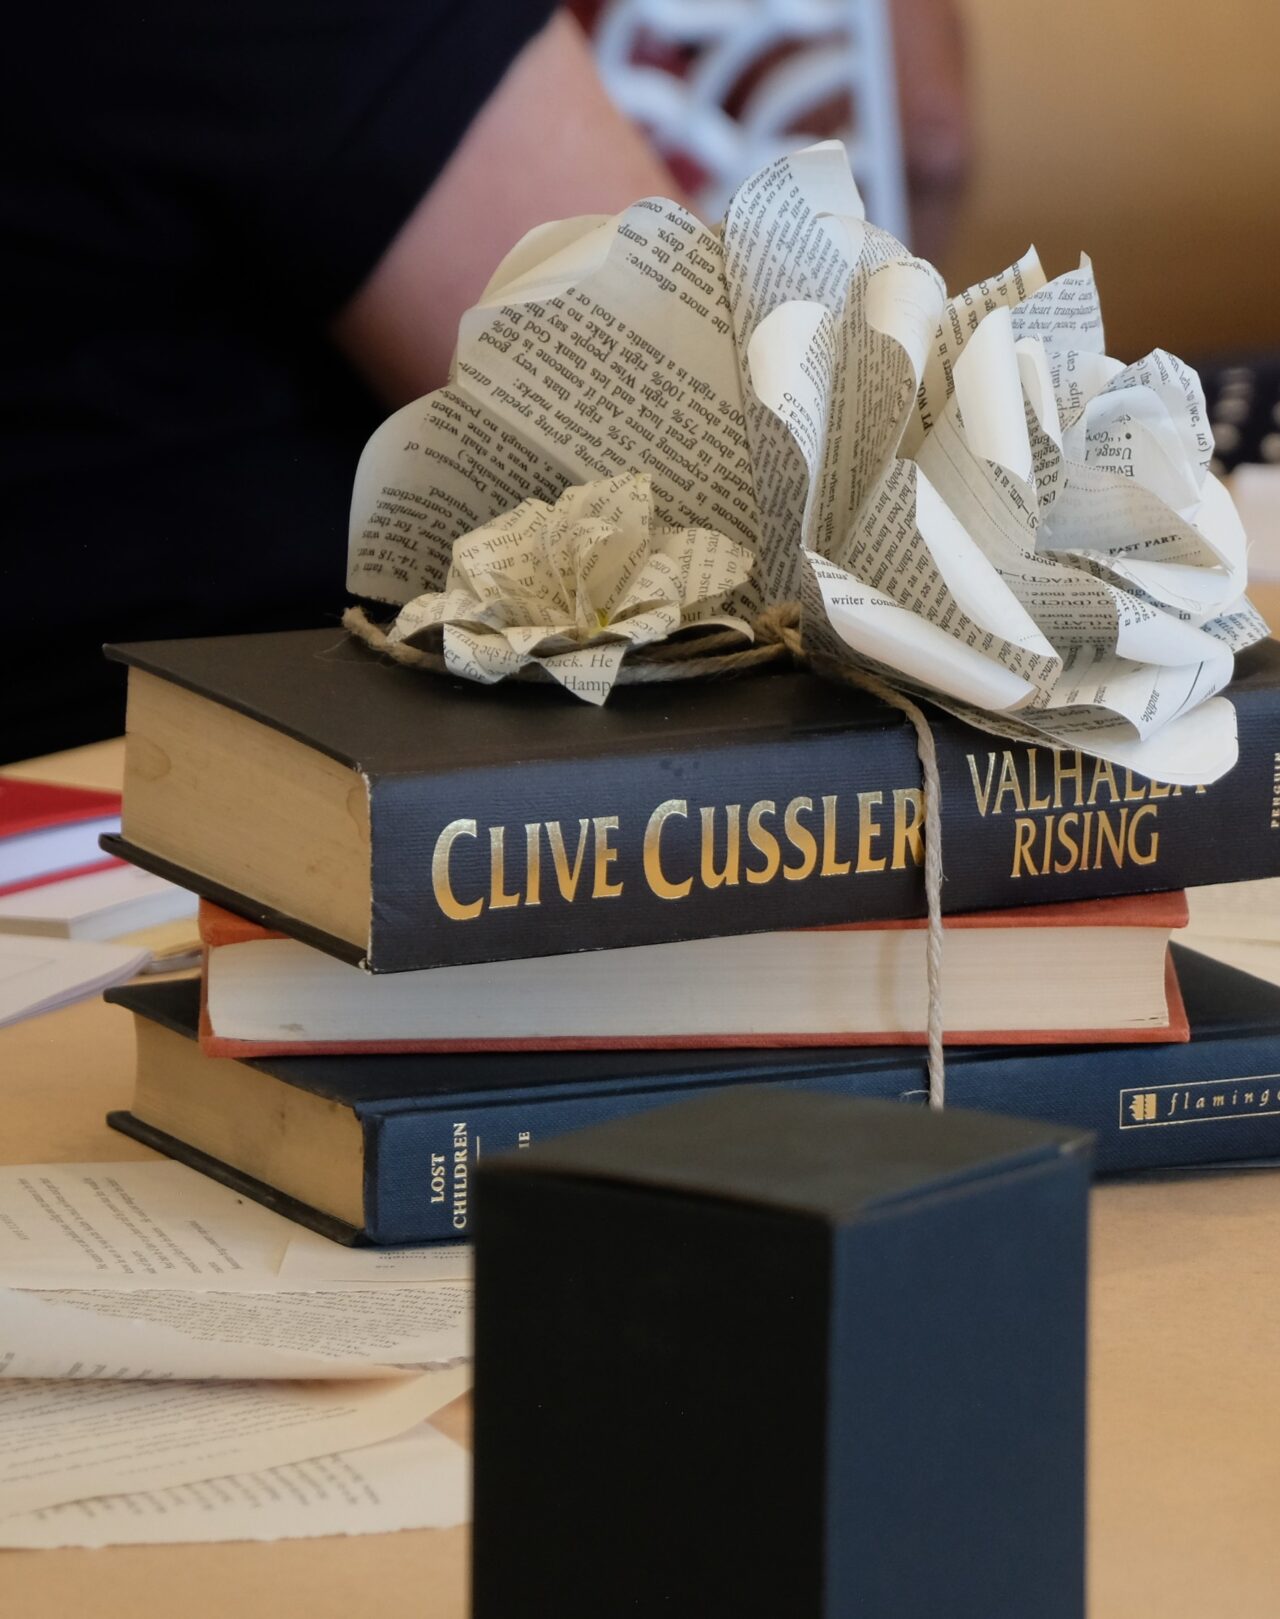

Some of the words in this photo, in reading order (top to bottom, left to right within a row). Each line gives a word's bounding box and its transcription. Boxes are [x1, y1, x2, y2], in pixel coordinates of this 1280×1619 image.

[748, 189, 762, 215] also
[789, 186, 800, 199] to
[777, 199, 790, 218] the
[790, 193, 805, 220] will
[664, 212, 696, 235] snow
[752, 202, 767, 239] recall
[657, 227, 685, 253] days.
[775, 220, 791, 252] make
[651, 246, 671, 264] the
[685, 248, 715, 274] early
[744, 238, 757, 263] here
[751, 219, 781, 293] improvement
[625, 252, 677, 293] effective:
[671, 261, 714, 295] around
[795, 272, 808, 294] but
[500, 306, 524, 325] But
[590, 304, 617, 327] fool
[679, 292, 710, 318] more
[1028, 303, 1052, 315] heart
[491, 320, 520, 346] 60%
[523, 320, 551, 344] God
[546, 314, 569, 333] say
[585, 321, 619, 352] Make
[711, 316, 732, 335] the
[478, 328, 512, 354] good
[570, 331, 611, 363] people
[626, 330, 666, 365] fanatic
[512, 352, 537, 377] very
[554, 340, 587, 370] thank
[619, 346, 649, 372] right
[454, 361, 492, 386] atten-
[535, 348, 585, 389] someone
[590, 368, 612, 390] lets
[610, 361, 636, 389] Wise
[512, 378, 553, 412] marks:
[542, 375, 571, 401] thats
[611, 385, 636, 405] and
[639, 384, 669, 409] right
[650, 371, 686, 402] 100%
[687, 376, 716, 401] right
[431, 400, 462, 422] when
[438, 381, 482, 419] posses-
[490, 386, 534, 418] special
[574, 399, 603, 424] right
[595, 395, 624, 418] And
[687, 398, 722, 427] about
[424, 413, 458, 436] write:
[534, 414, 573, 445] giving
[554, 410, 603, 448] question
[625, 416, 655, 442] more
[637, 403, 664, 430] luck
[670, 409, 699, 436] 75%
[460, 434, 488, 457] shall
[467, 422, 492, 444] time
[606, 425, 637, 451] 55%
[665, 425, 698, 451] great
[701, 430, 735, 459] about
[500, 431, 539, 464] though
[601, 447, 627, 466] and
[655, 436, 709, 483] expecting
[697, 449, 713, 467] its
[424, 447, 488, 493] Depression
[507, 452, 528, 472] was
[638, 448, 696, 492] genuinely
[508, 469, 531, 491] that
[710, 481, 731, 500] use
[381, 487, 453, 519] contractions
[429, 485, 479, 522] required.
[875, 492, 891, 514] have
[898, 483, 913, 505] had
[711, 503, 758, 546] someone
[886, 501, 904, 524] been
[393, 519, 413, 533] for
[871, 523, 892, 553] known
[895, 522, 910, 543] per
[884, 541, 899, 565] road
[1109, 543, 1140, 555] PAST
[1144, 534, 1182, 548] PART.
[865, 553, 874, 566] as
[893, 548, 914, 576] chairs,
[915, 554, 929, 575] that
[886, 576, 898, 596] and
[907, 574, 919, 589] we
[831, 594, 864, 605] writer
[1177, 610, 1191, 620] in
[590, 653, 613, 668] He
[1012, 804, 1159, 878] RISING
[432, 818, 623, 921] CLIVE
[643, 788, 925, 901] CUSSLER
[430, 1153, 445, 1203] LOST
[453, 1122, 468, 1229] CHILDREN
